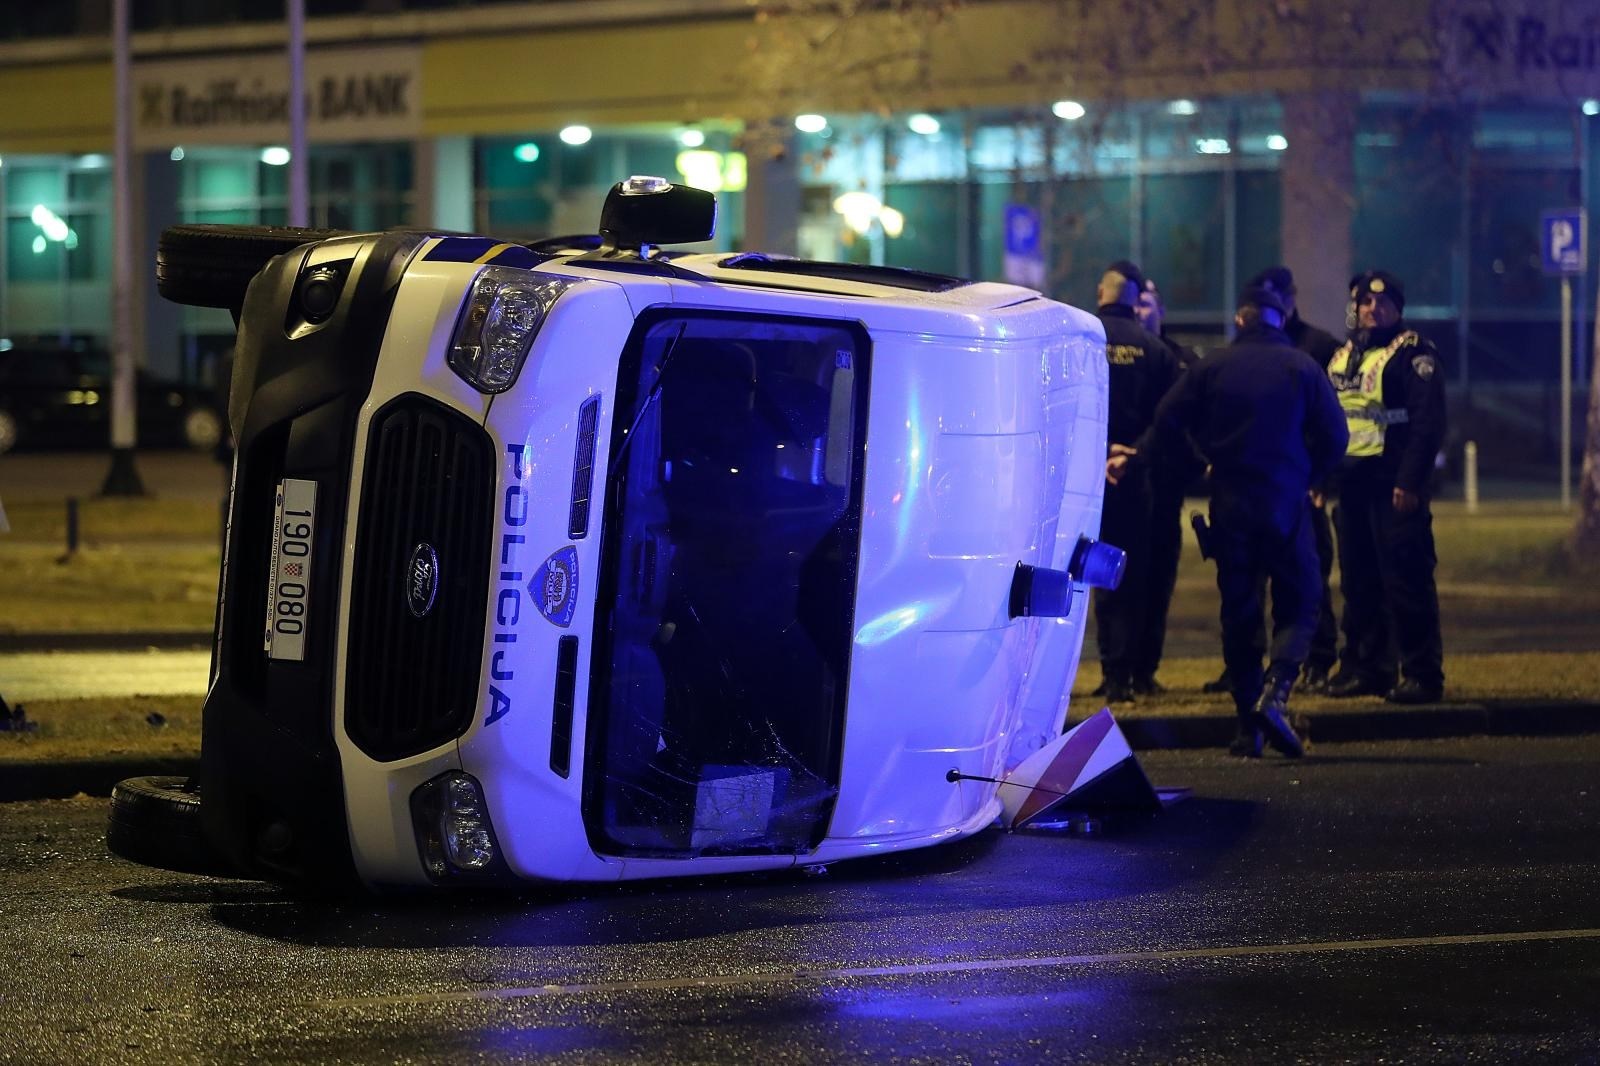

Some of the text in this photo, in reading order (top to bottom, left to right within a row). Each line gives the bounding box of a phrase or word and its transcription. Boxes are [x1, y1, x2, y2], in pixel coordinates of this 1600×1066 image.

[320, 74, 410, 120] BANK
[1551, 220, 1573, 262] P
[275, 510, 312, 635] 190 080
[413, 558, 433, 601] Ford
[484, 444, 531, 727] POLICIJA
[563, 551, 578, 625] POLICIJA
